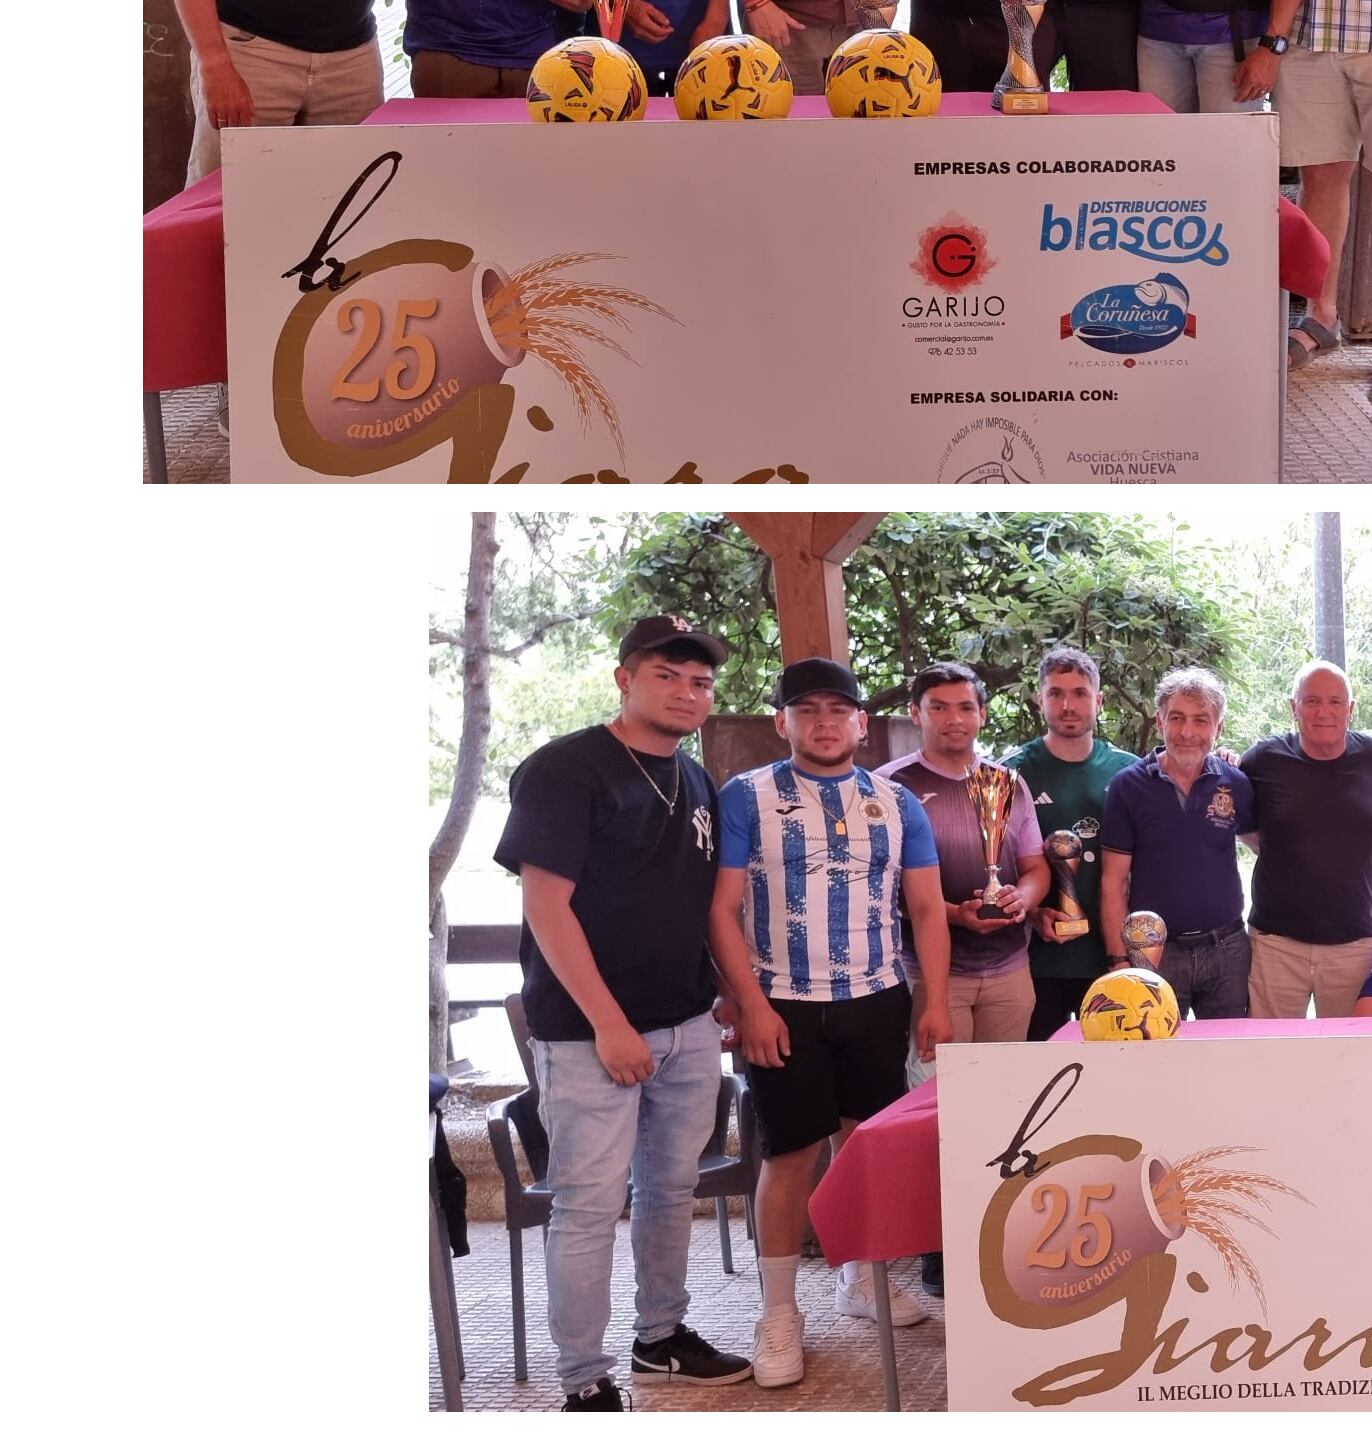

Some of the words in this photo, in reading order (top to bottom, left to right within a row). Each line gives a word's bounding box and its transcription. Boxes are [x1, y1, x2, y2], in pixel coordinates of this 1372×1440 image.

[913, 161, 1011, 176] EMPRESAS
[1016, 159, 1176, 174] COLABORADORAS
[1090, 200, 1207, 213] DISTRIBUCIONES
[1040, 202, 1208, 254] blasco
[902, 296, 1005, 318] GARIJO
[1100, 293, 1120, 309] La
[1086, 303, 1170, 322] Coruñesa
[930, 321, 942, 329] POR
[330, 297, 441, 403] 25
[910, 390, 986, 405] EMPRESA
[990, 389, 1075, 404] SOLIDARIA
[1079, 389, 1119, 402] CON:
[347, 376, 461, 440] aniversario
[985, 417, 1021, 437] IMPOSIBLE
[1066, 449, 1138, 463] Asociación
[1142, 448, 1200, 462] Cristiana
[1090, 462, 1126, 476] VIDA
[1129, 462, 1176, 475] NUEVA
[1025, 1182, 1116, 1269] 25
[1039, 1248, 1132, 1300] aniversario
[1137, 1386, 1155, 1402] IL
[1159, 1384, 1233, 1401] MEGLIO
[1237, 1382, 1296, 1400] DELLA
